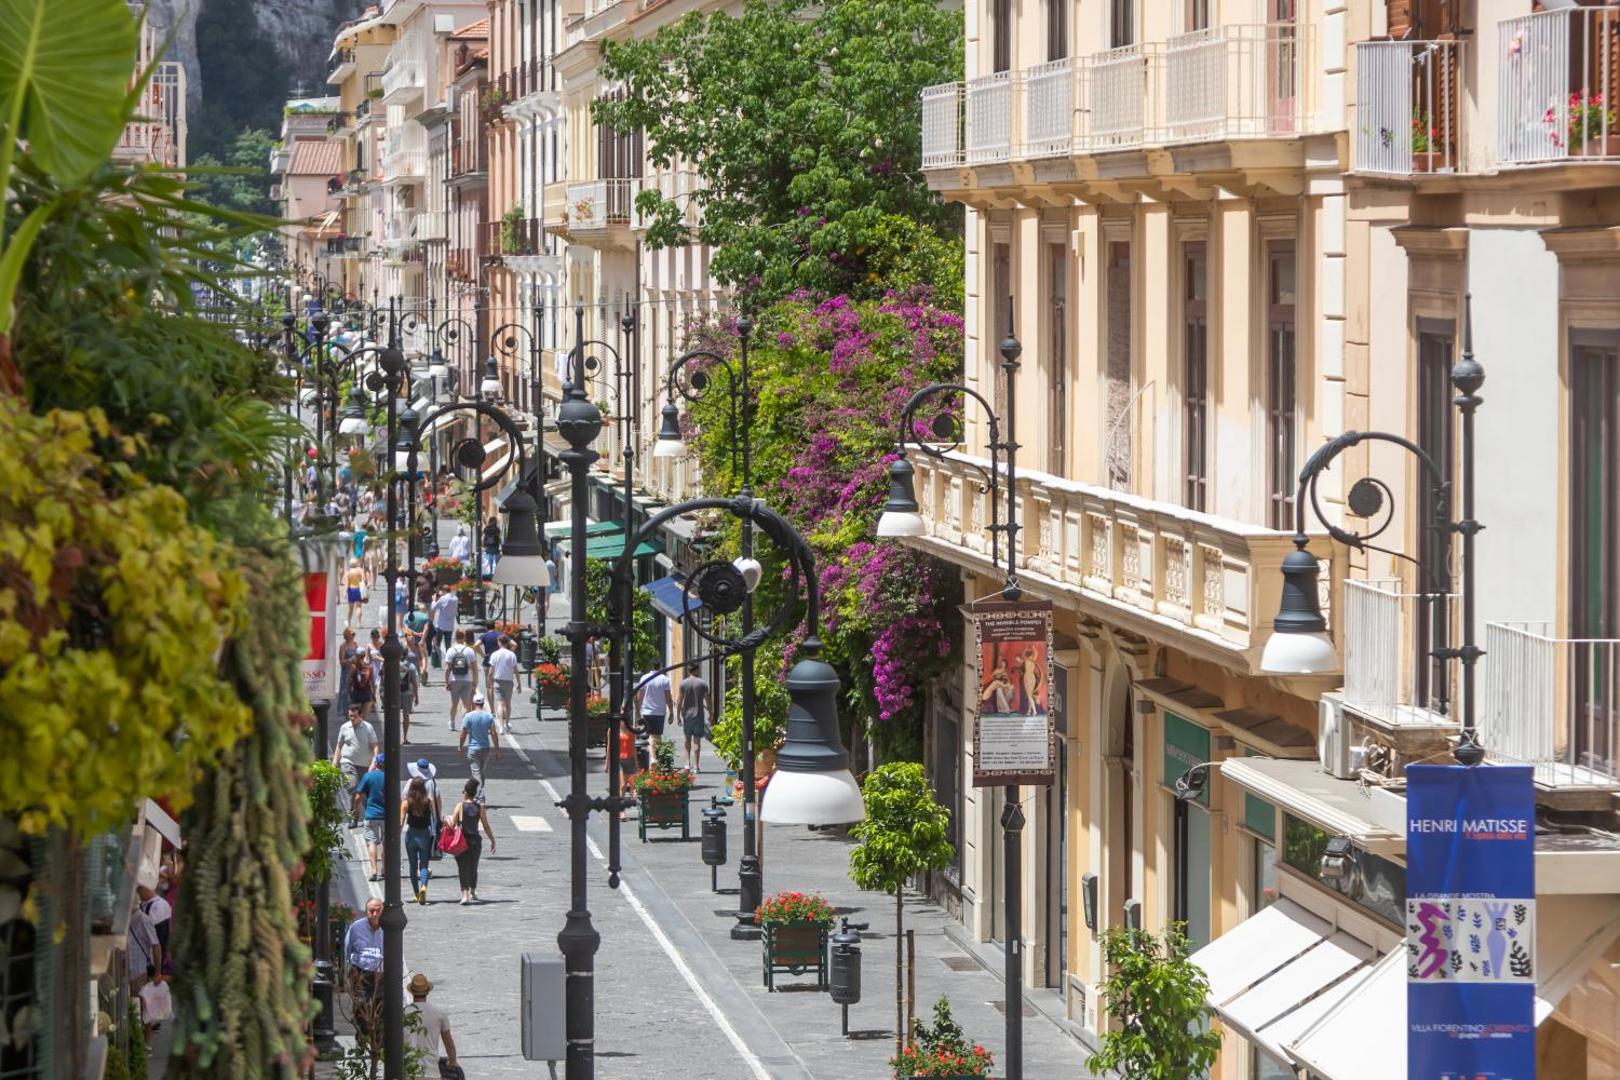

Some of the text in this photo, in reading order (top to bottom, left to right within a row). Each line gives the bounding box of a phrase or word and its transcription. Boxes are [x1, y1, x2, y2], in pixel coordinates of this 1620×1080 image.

[1410, 819, 1527, 833] HENRI MATISSE
[1410, 1024, 1432, 1033] VILLA
[1433, 1024, 1484, 1033] FIORENTINO
